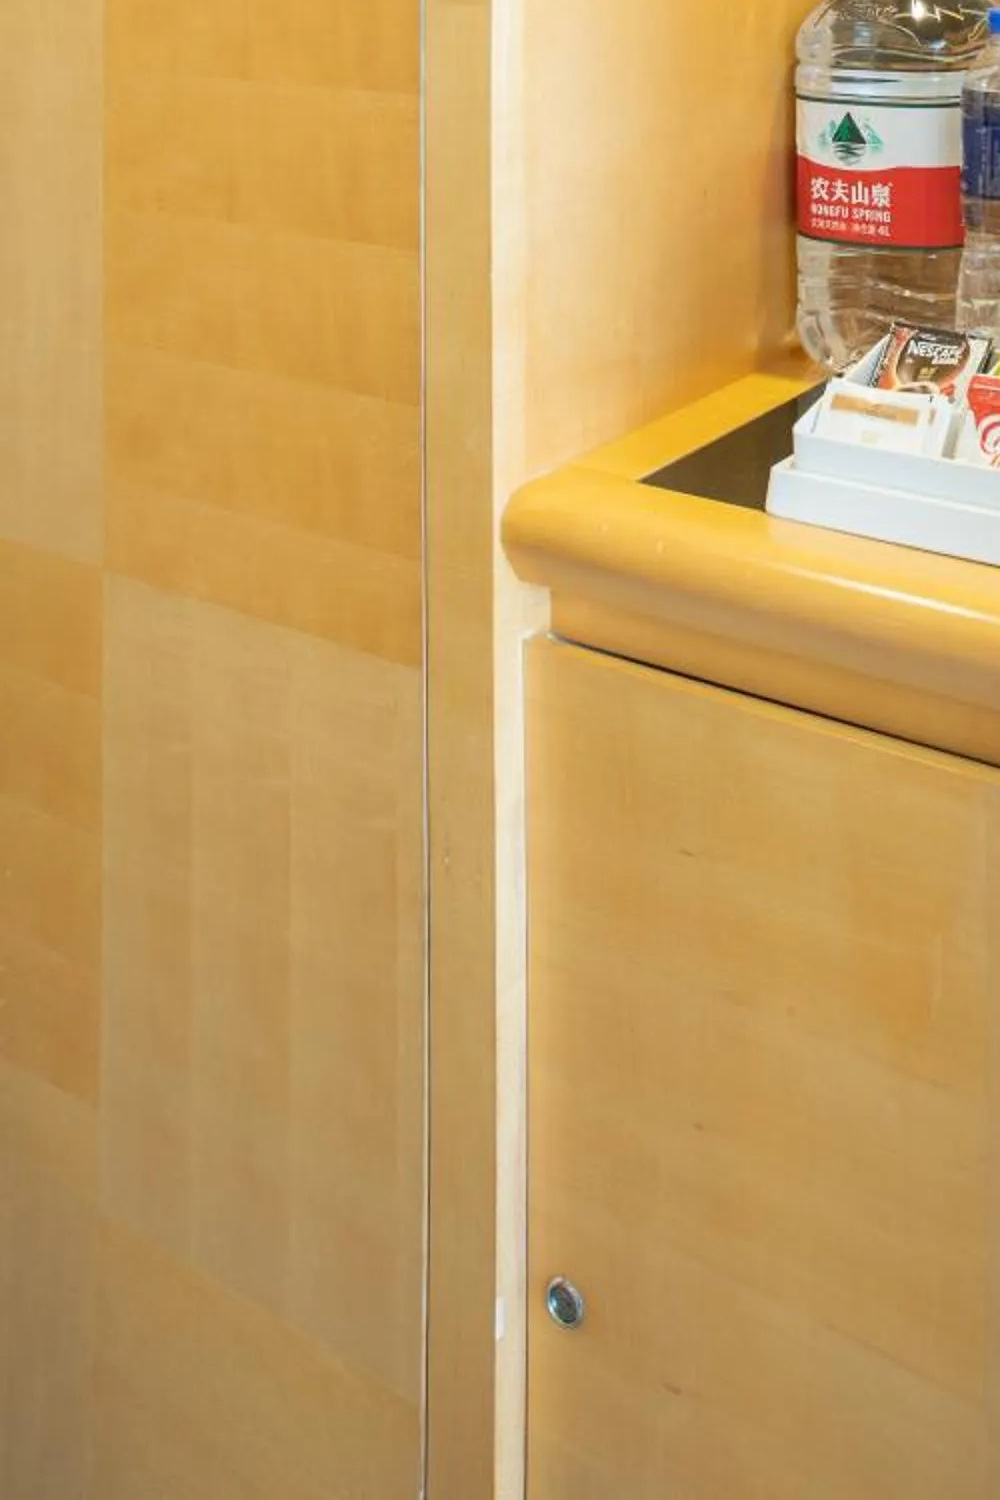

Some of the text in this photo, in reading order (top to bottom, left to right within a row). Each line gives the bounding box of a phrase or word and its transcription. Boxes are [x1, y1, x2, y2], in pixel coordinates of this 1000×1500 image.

[811, 177, 891, 208] 农夫山泉
[811, 202, 891, 223] NONGFU SPRING
